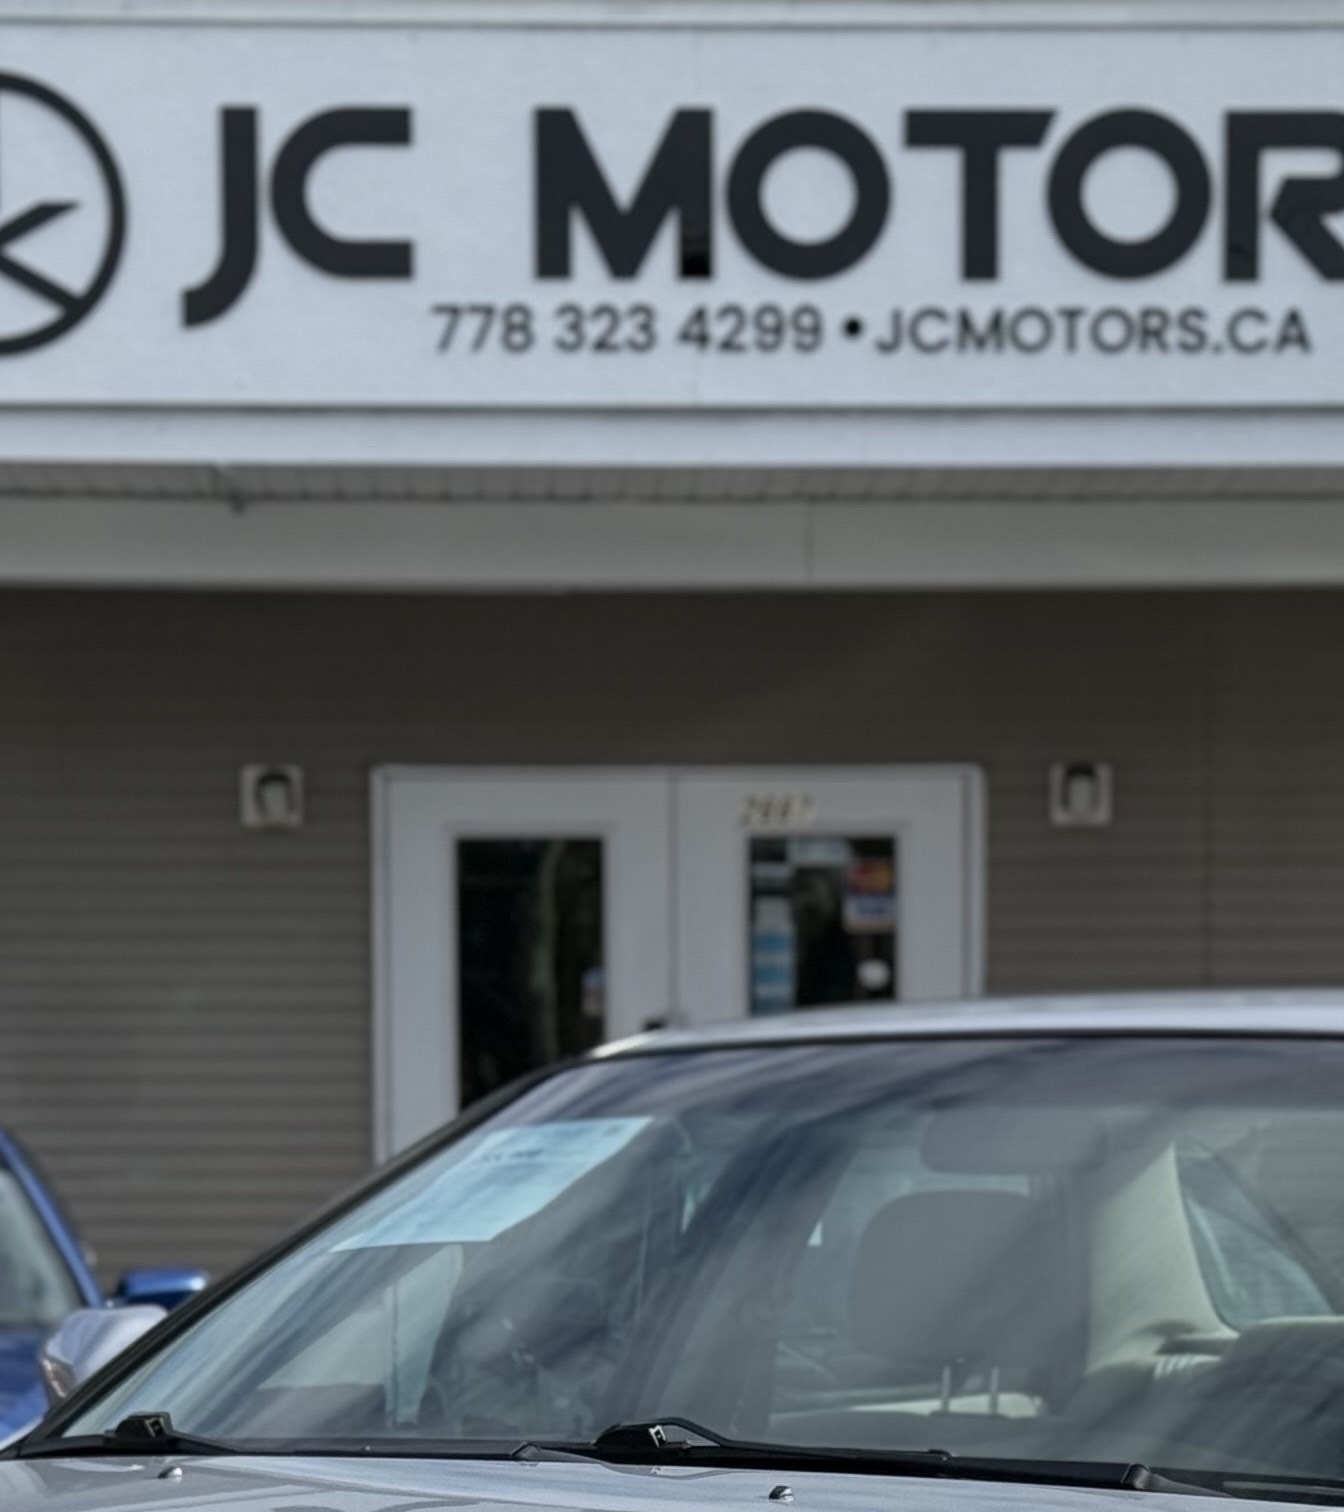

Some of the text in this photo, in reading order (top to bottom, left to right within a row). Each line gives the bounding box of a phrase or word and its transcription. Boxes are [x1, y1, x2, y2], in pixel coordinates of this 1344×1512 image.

[182, 106, 412, 329] JC
[432, 306, 1311, 357] 778 323 4299 JCMOTORS.CA
